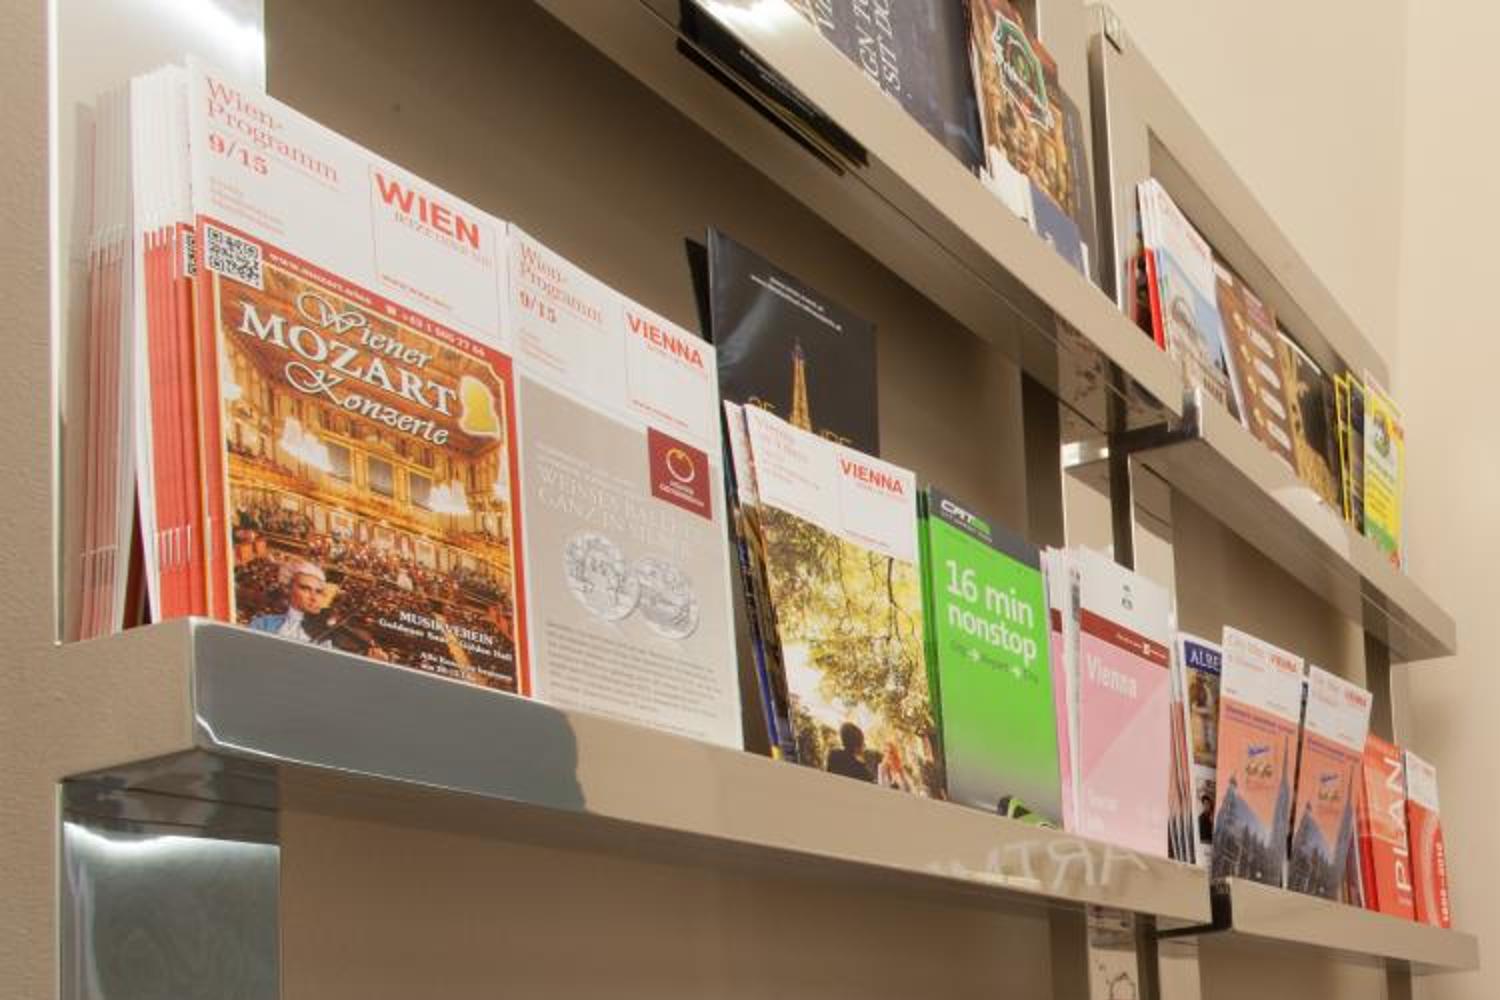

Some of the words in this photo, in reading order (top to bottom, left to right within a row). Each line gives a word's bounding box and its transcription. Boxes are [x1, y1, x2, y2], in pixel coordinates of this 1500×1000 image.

[207, 99, 338, 184] Programm
[375, 171, 480, 250] WIEN
[238, 301, 457, 416] MOZART
[296, 290, 433, 369] Wiener
[627, 311, 704, 369] VIENNA
[285, 361, 449, 444] Konzerte
[839, 459, 904, 495] VIENNA
[946, 559, 978, 603] 16
[985, 582, 1035, 630] min
[948, 603, 1038, 668] nonstop
[1086, 653, 1138, 700] Vienna
